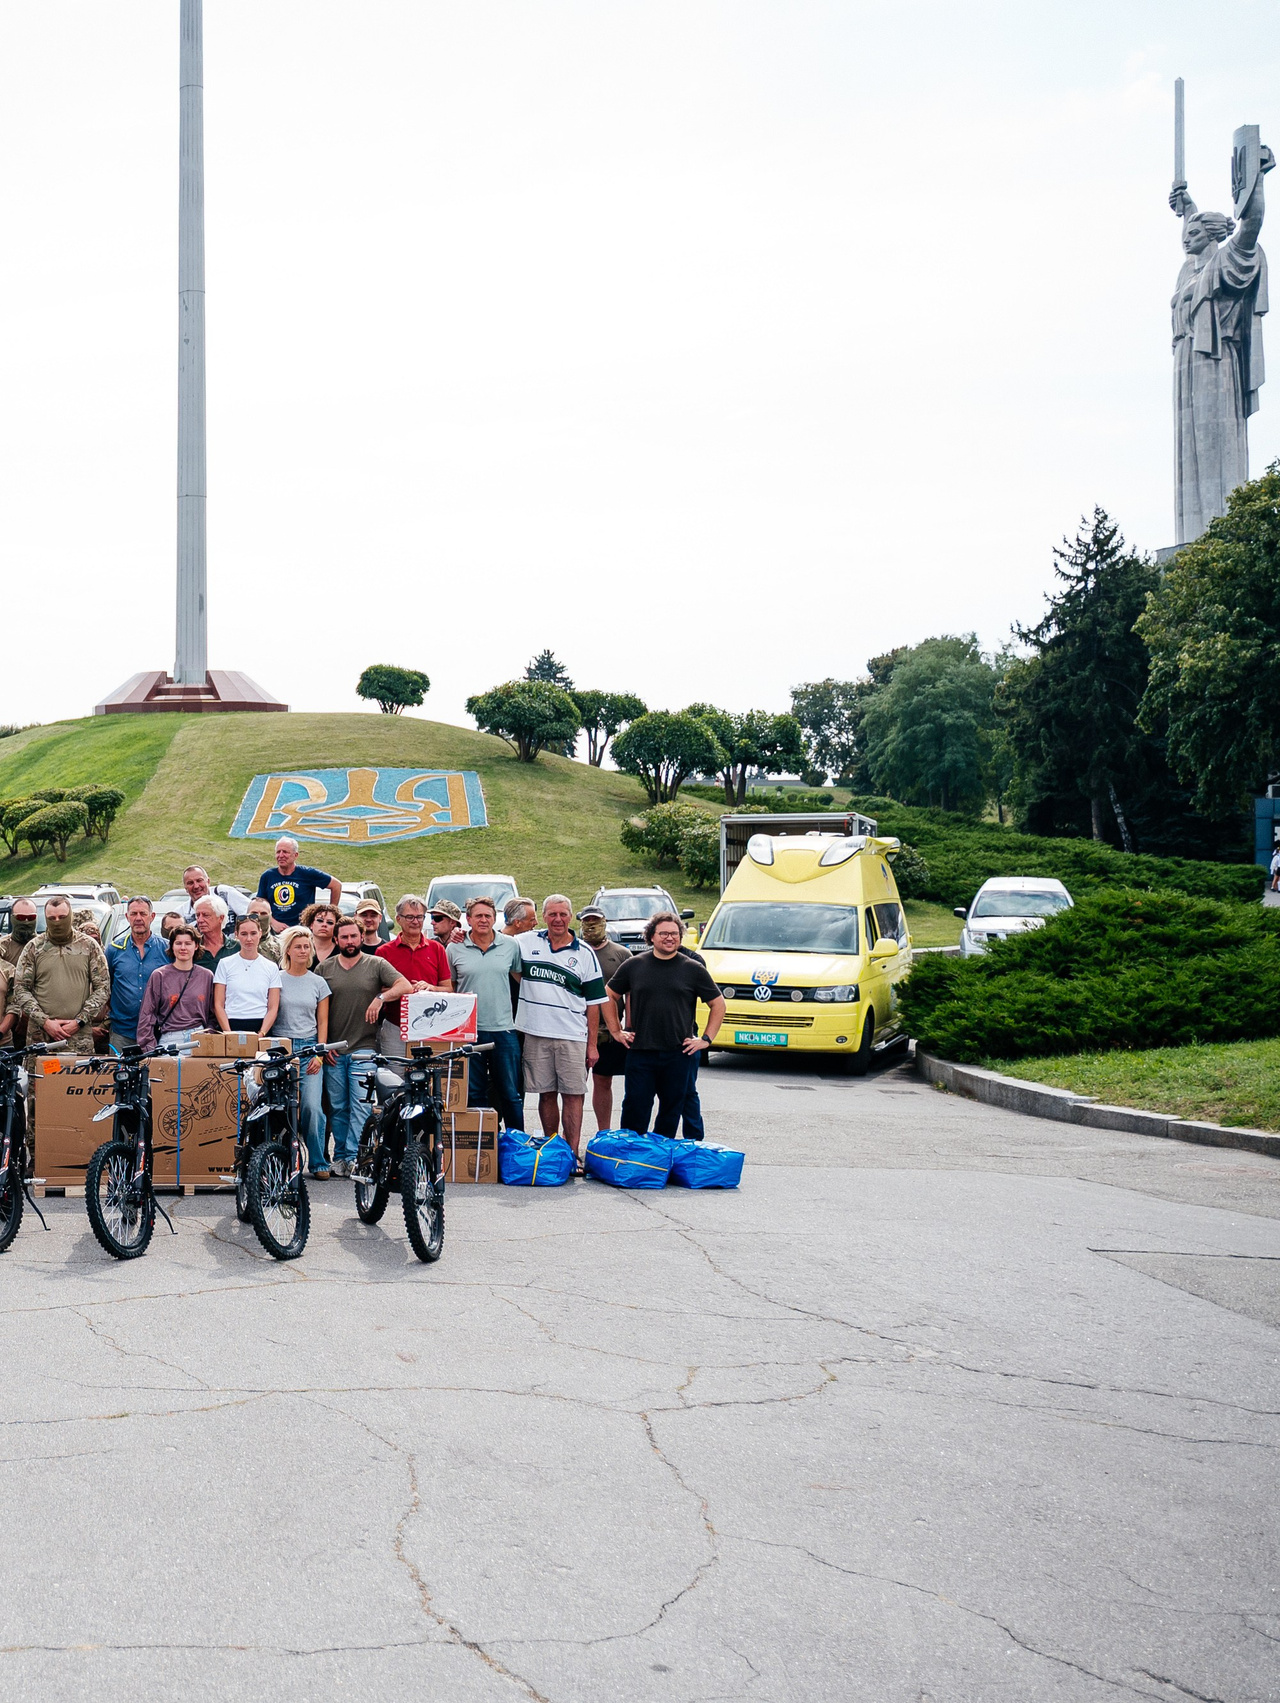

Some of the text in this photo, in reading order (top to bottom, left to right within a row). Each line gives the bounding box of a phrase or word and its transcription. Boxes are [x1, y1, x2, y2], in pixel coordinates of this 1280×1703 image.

[530, 965, 567, 985] GUINNESS
[400, 995, 409, 1041] DOLMAR
[761, 1034, 777, 1043] MCR
[66, 1085, 83, 1095] Go
[87, 1086, 109, 1095] for
